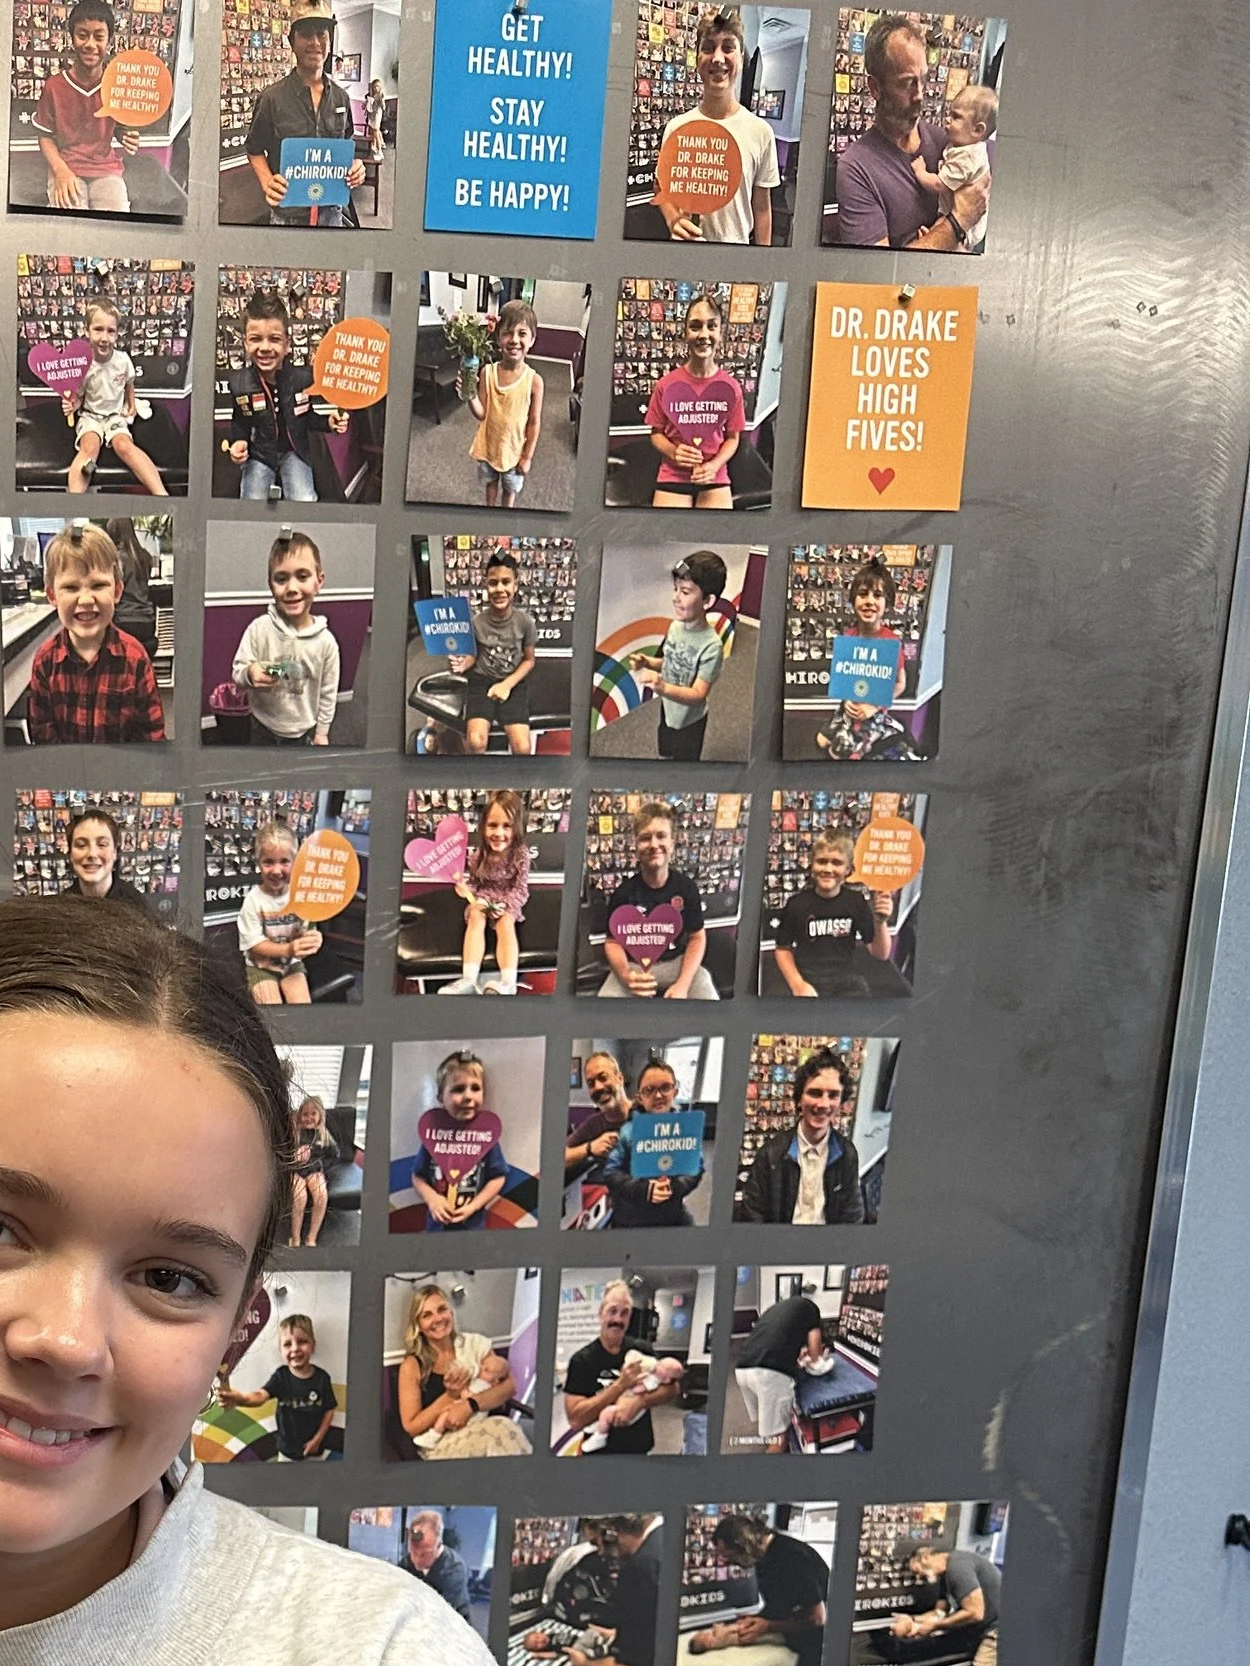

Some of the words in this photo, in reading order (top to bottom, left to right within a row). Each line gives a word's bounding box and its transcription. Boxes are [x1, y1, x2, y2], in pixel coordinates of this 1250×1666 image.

[501, 13, 544, 43] GET
[117, 62, 143, 73] THANK
[144, 65, 160, 76] YOU
[468, 46, 572, 79] HEALTHY!
[116, 75, 128, 85] DR.
[130, 77, 157, 88] DRAKE
[110, 87, 125, 97] FOR
[126, 89, 160, 101] KEEPING
[110, 99, 122, 108] ME
[123, 100, 159, 113] HEALTHY!
[490, 97, 544, 127] STAY
[463, 130, 567, 163] HEALTHY!
[677, 135, 708, 149] THANK
[711, 137, 728, 151] YOU
[305, 148, 323, 163] I'M
[324, 149, 331, 162] A
[677, 151, 692, 164] DR.
[695, 152, 725, 166] DRAKE
[285, 166, 348, 180] #CHIROKID!
[671, 167, 689, 178] FOR
[691, 168, 729, 182] KEEPING
[455, 178, 482, 207] BE
[490, 180, 570, 212] HAPPY!
[670, 182, 684, 193] ME
[685, 183, 727, 197] HEALTHY!
[831, 306, 869, 340] DR.
[875, 308, 959, 342] DRAKE
[335, 331, 366, 347] THANK
[367, 338, 386, 353] YOU
[333, 349, 348, 360] DR.
[349, 351, 380, 368] DRAKE
[851, 345, 930, 378] LOVES
[324, 362, 342, 373] FOR
[342, 365, 380, 384] KEEPING
[322, 376, 335, 388] ME
[336, 378, 377, 397] HEALTHY!
[670, 402, 673, 412] I
[675, 402, 694, 412] LOVE
[695, 401, 728, 412] GETTING
[857, 382, 917, 415] HIGH
[678, 414, 718, 424] ADJUSTED!
[846, 418, 924, 452] FIVES!
[853, 646, 868, 660] I'M
[870, 648, 877, 661] A
[835, 661, 892, 680] #CHIROKID!
[426, 1129, 430, 1139] I
[431, 1130, 453, 1141] LOVE
[455, 1131, 492, 1142] GETTING
[654, 1123, 670, 1137] I'M
[673, 1123, 680, 1136] A
[434, 1143, 481, 1155] ADJUSTED!
[637, 1137, 696, 1153] #CHIROKID!
